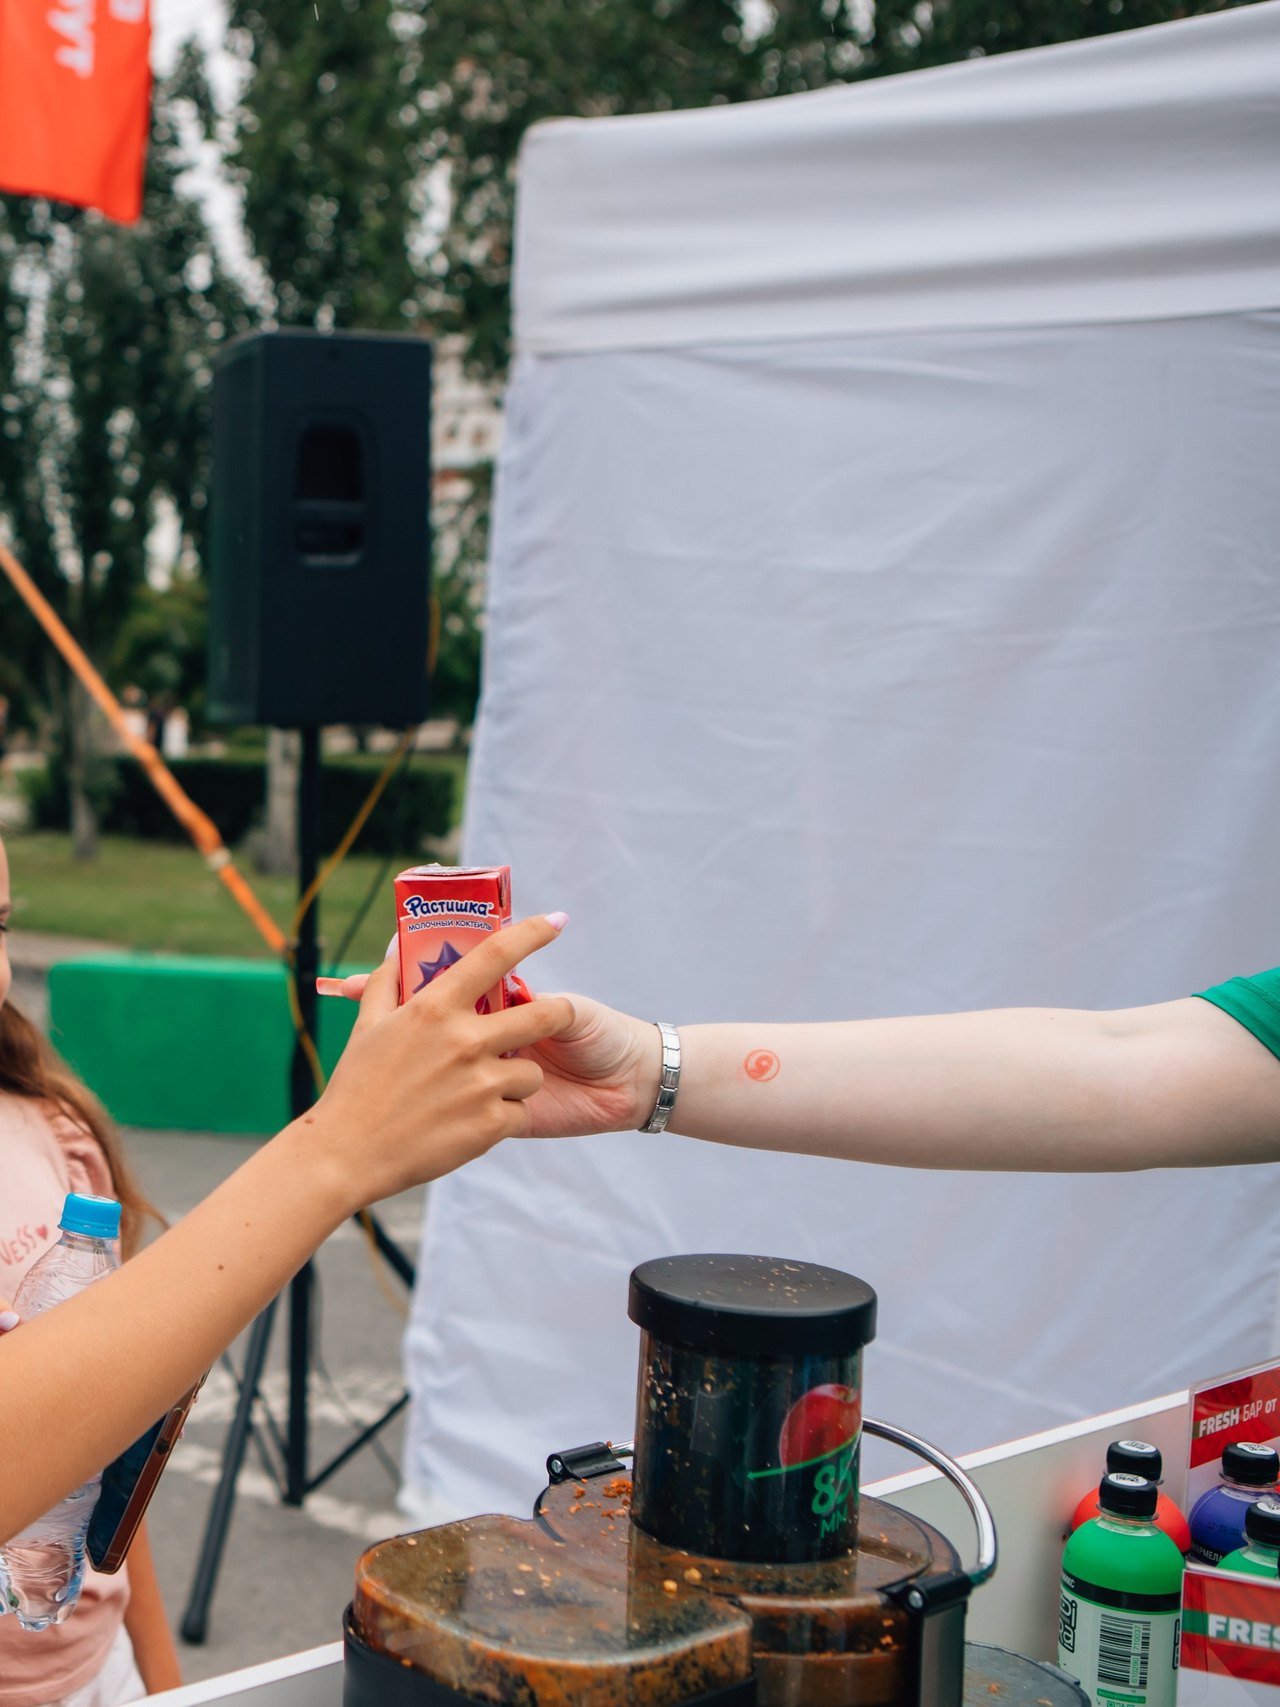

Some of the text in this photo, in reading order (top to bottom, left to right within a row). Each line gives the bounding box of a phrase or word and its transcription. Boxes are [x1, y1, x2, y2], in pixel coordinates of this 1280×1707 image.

[406, 896, 488, 917] Растишка
[1199, 1407, 1240, 1438] FRESH
[1243, 1400, 1263, 1422] БАР
